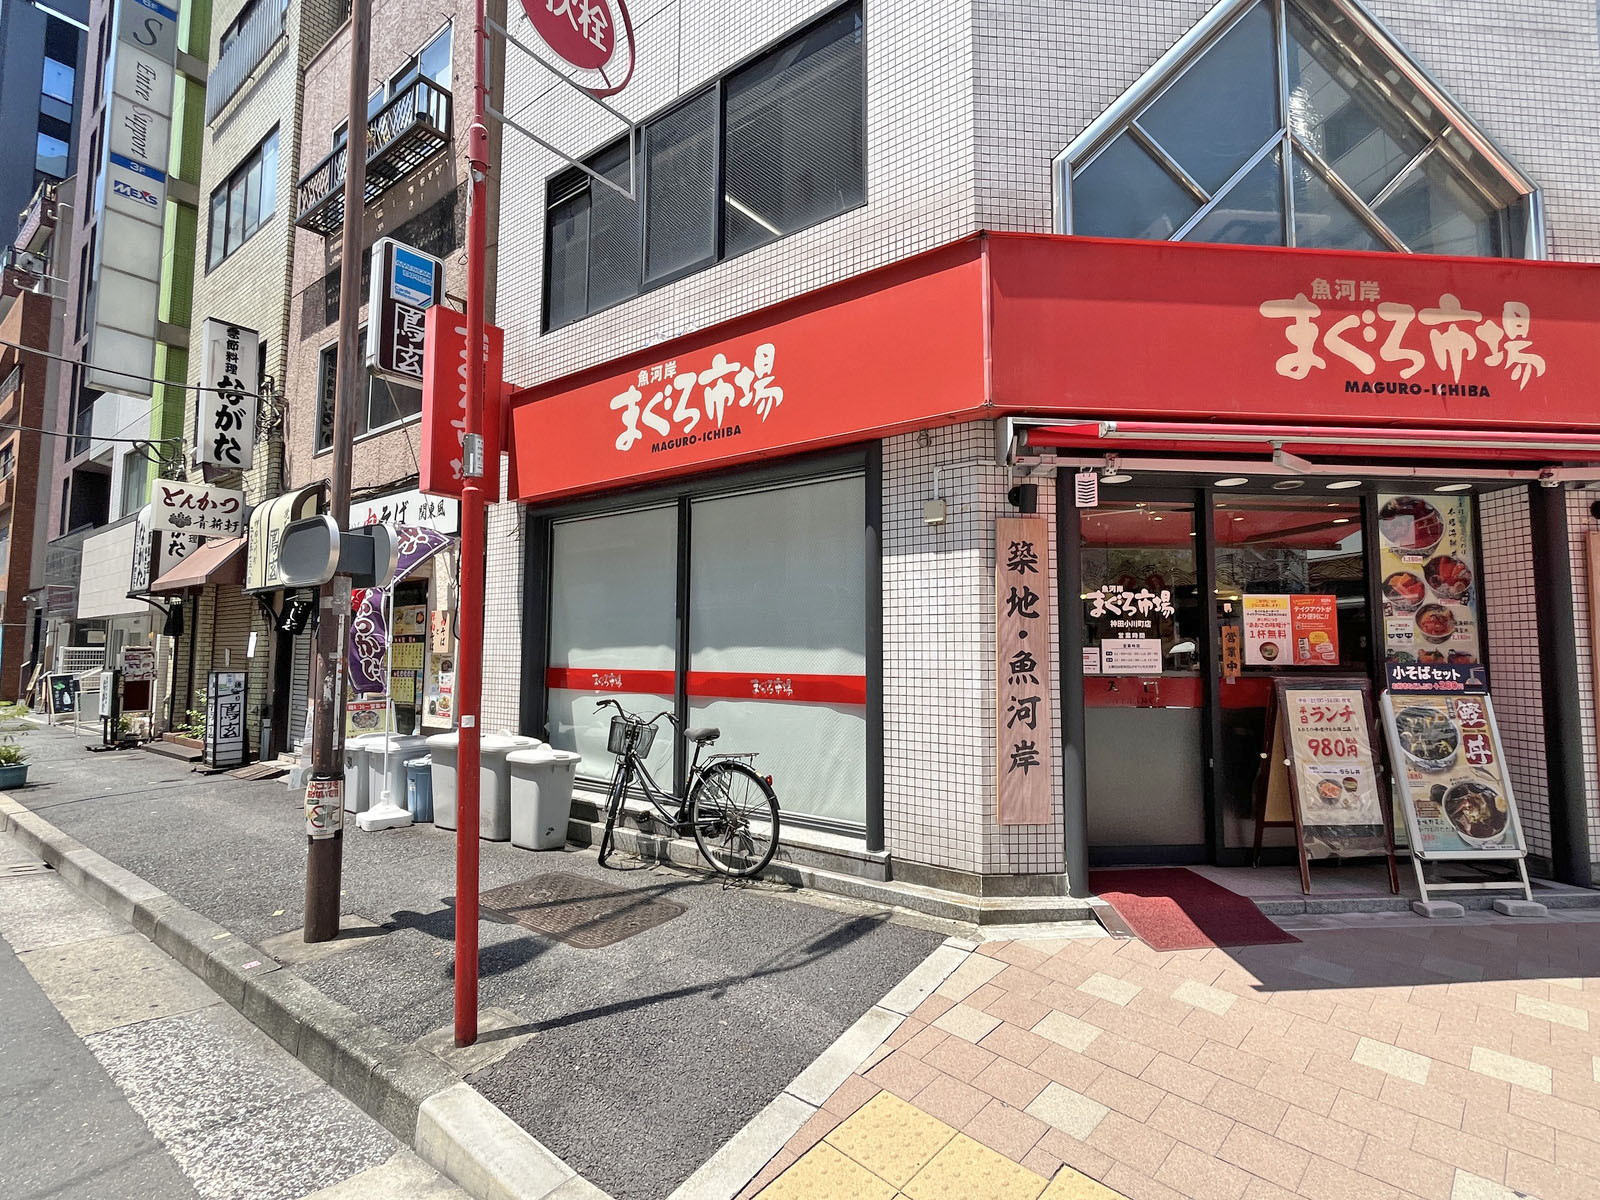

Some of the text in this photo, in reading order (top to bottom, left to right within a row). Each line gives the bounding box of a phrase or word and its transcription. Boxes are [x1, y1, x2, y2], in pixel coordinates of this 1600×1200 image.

[124, 61, 157, 160] Entre Support
[129, 162, 146, 174] 3F
[113, 180, 158, 206] MEXS
[1310, 278, 1381, 302] 魚河岸
[225, 326, 241, 376] 季節料理
[1259, 292, 1547, 391] まぐろ市場
[636, 360, 677, 388] 魚河岸
[609, 343, 784, 451] まぐろ市場
[1344, 380, 1491, 398] MAGURO-ICHIBA
[213, 375, 247, 465] ながた
[650, 425, 742, 453] MAGURO-ICHIBA
[161, 486, 240, 514] とんかつ
[418, 499, 446, 521] 関東風
[1101, 585, 1124, 593] 魚河岸
[1081, 588, 1175, 619] まぐろ市場
[1293, 605, 1332, 613] テイクアウトが
[1109, 620, 1152, 628] 神田小川町店
[1005, 540, 1042, 776] 築地・魚河岸
[1224, 631, 1238, 673] 営業中
[1392, 665, 1461, 681] 小そばセット
[1299, 706, 1308, 724] 平日
[1309, 704, 1356, 723] ランチ
[1308, 738, 1358, 758] 980円
